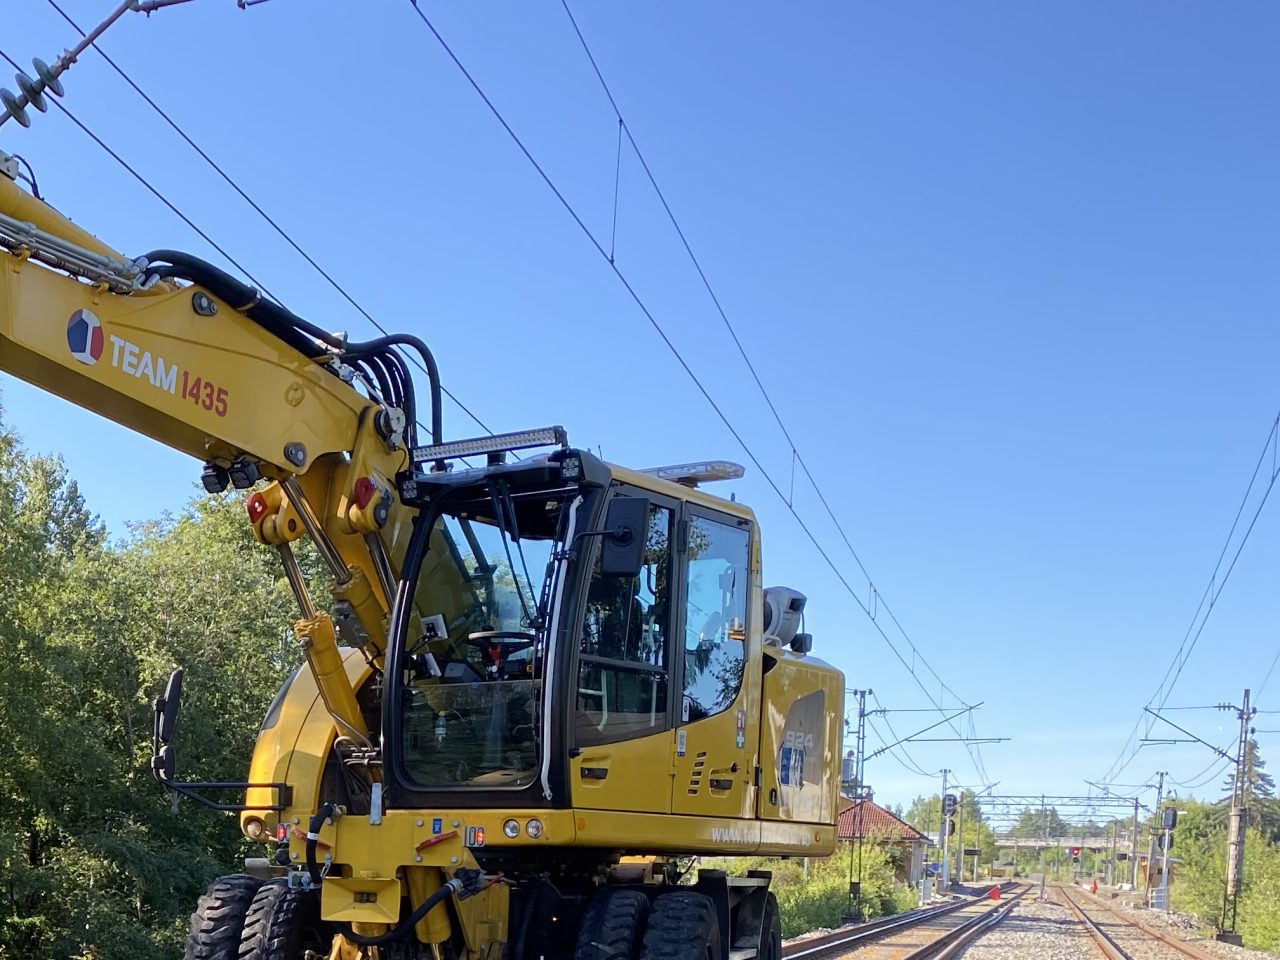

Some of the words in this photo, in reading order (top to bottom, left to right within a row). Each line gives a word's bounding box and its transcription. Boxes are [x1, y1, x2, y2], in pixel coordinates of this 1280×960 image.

[110, 334, 178, 394] TEAM
[181, 370, 229, 417] 1435
[786, 730, 813, 749] 924
